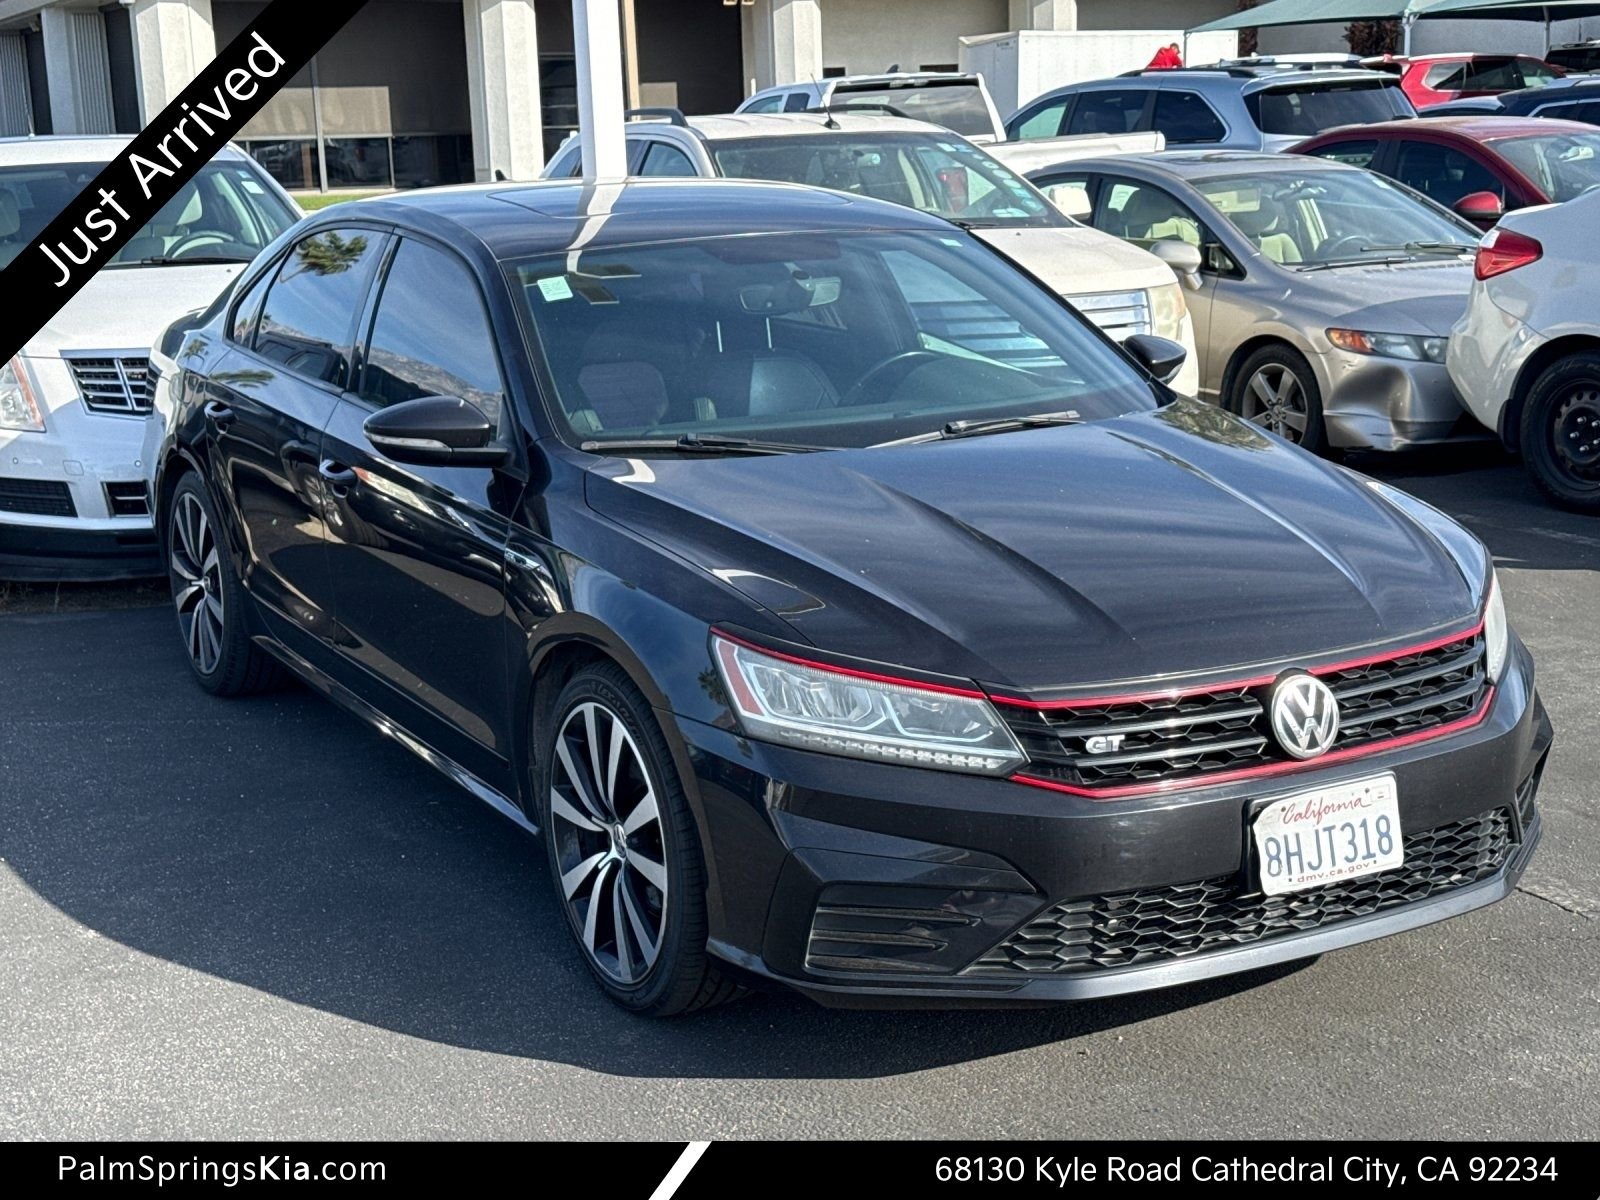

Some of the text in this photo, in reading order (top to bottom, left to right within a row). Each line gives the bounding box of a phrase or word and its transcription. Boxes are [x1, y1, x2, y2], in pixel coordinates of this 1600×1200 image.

[1085, 735, 1125, 755] GT
[1282, 795, 1372, 825] California
[1264, 814, 1394, 878] 8HJT318
[1297, 862, 1370, 883] dmv.ca.gov
